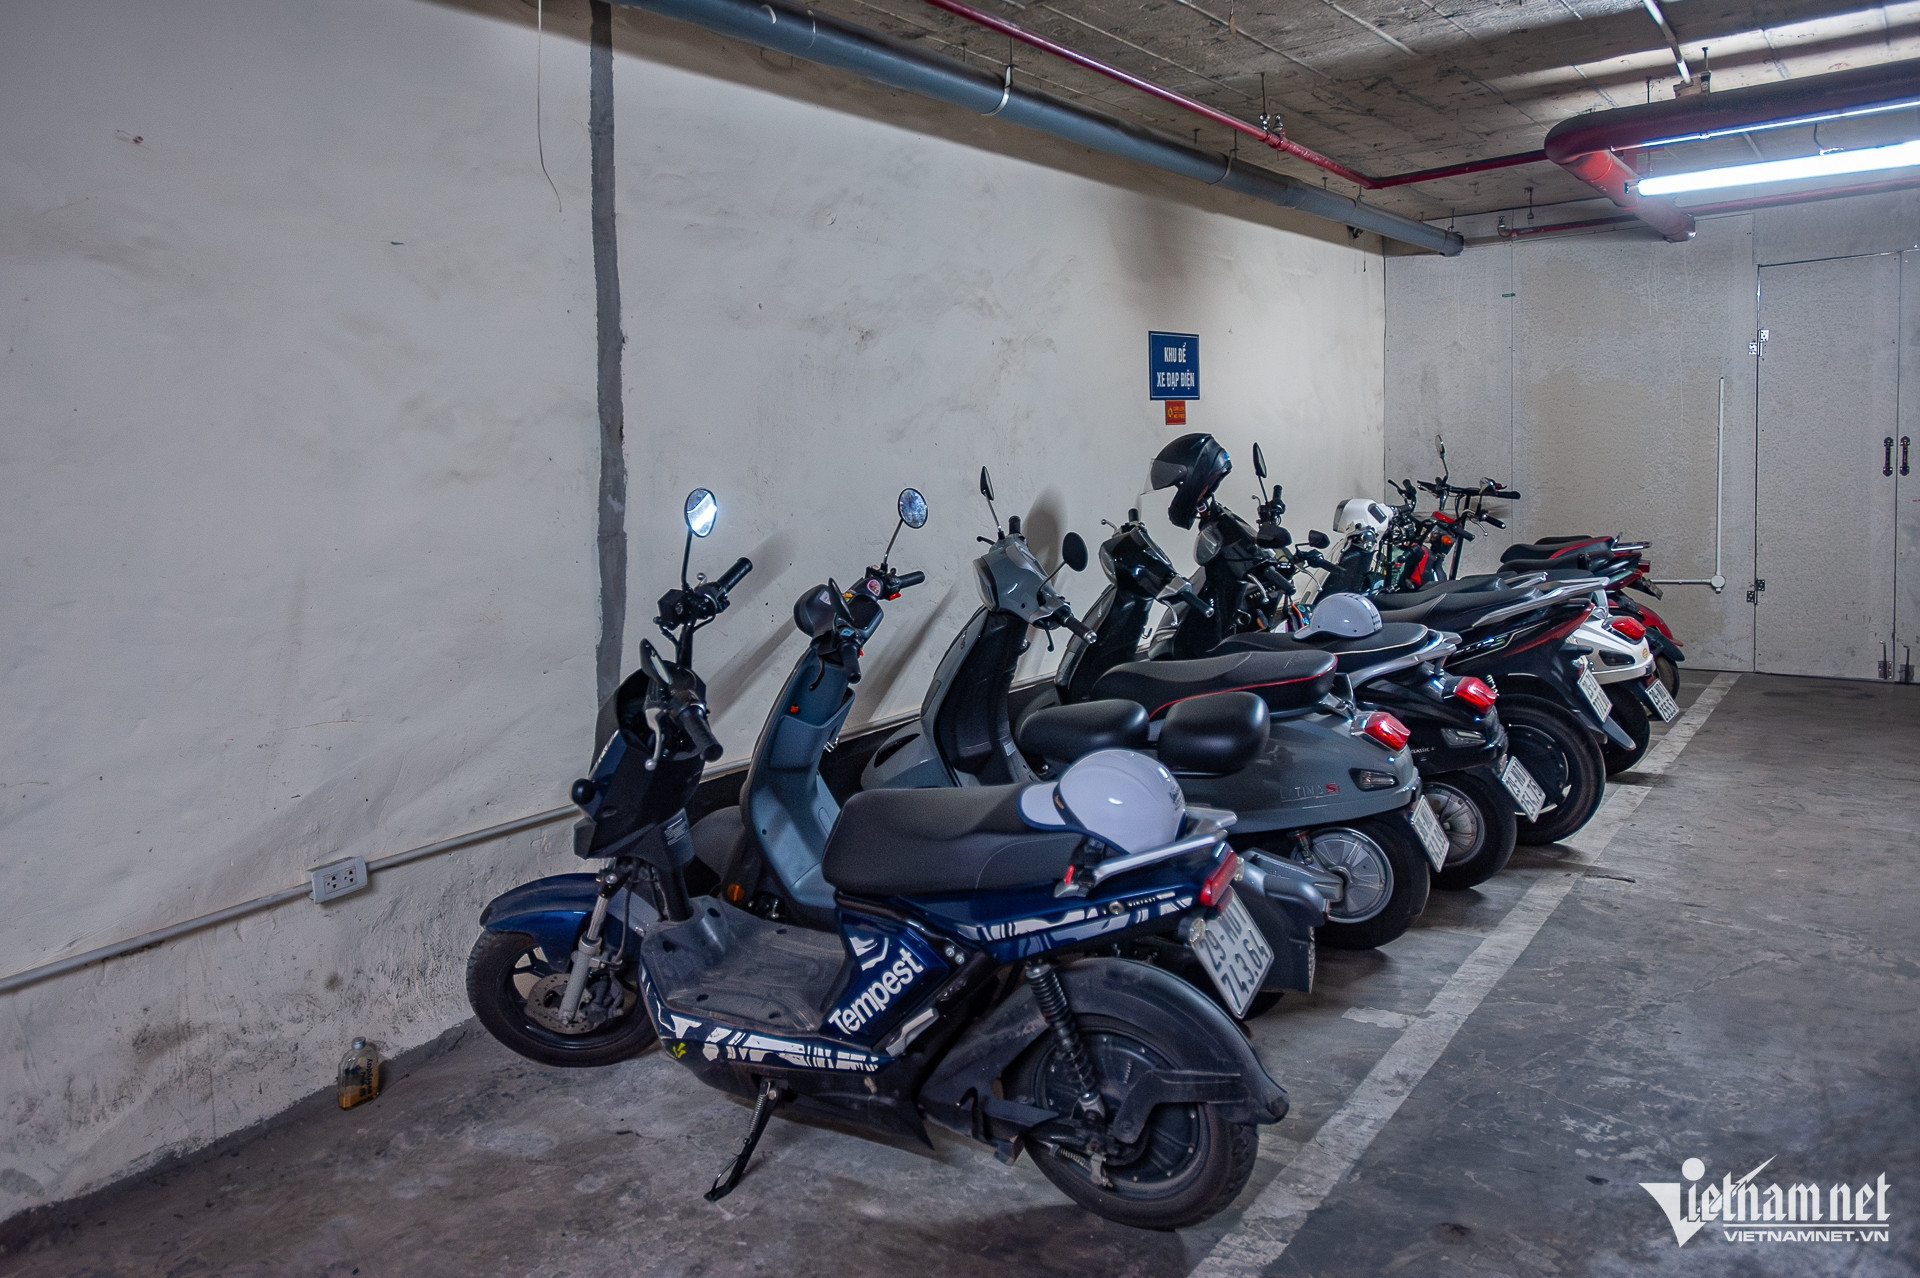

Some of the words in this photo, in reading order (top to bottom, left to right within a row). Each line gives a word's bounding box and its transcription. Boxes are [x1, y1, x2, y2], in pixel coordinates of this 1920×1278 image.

[1156, 372, 1166, 387] XE
[1180, 369, 1195, 390] ĐIỆN
[1164, 347, 1177, 363] KHU
[828, 948, 924, 1036] Tempest
[1221, 929, 1269, 1010] 743.64
